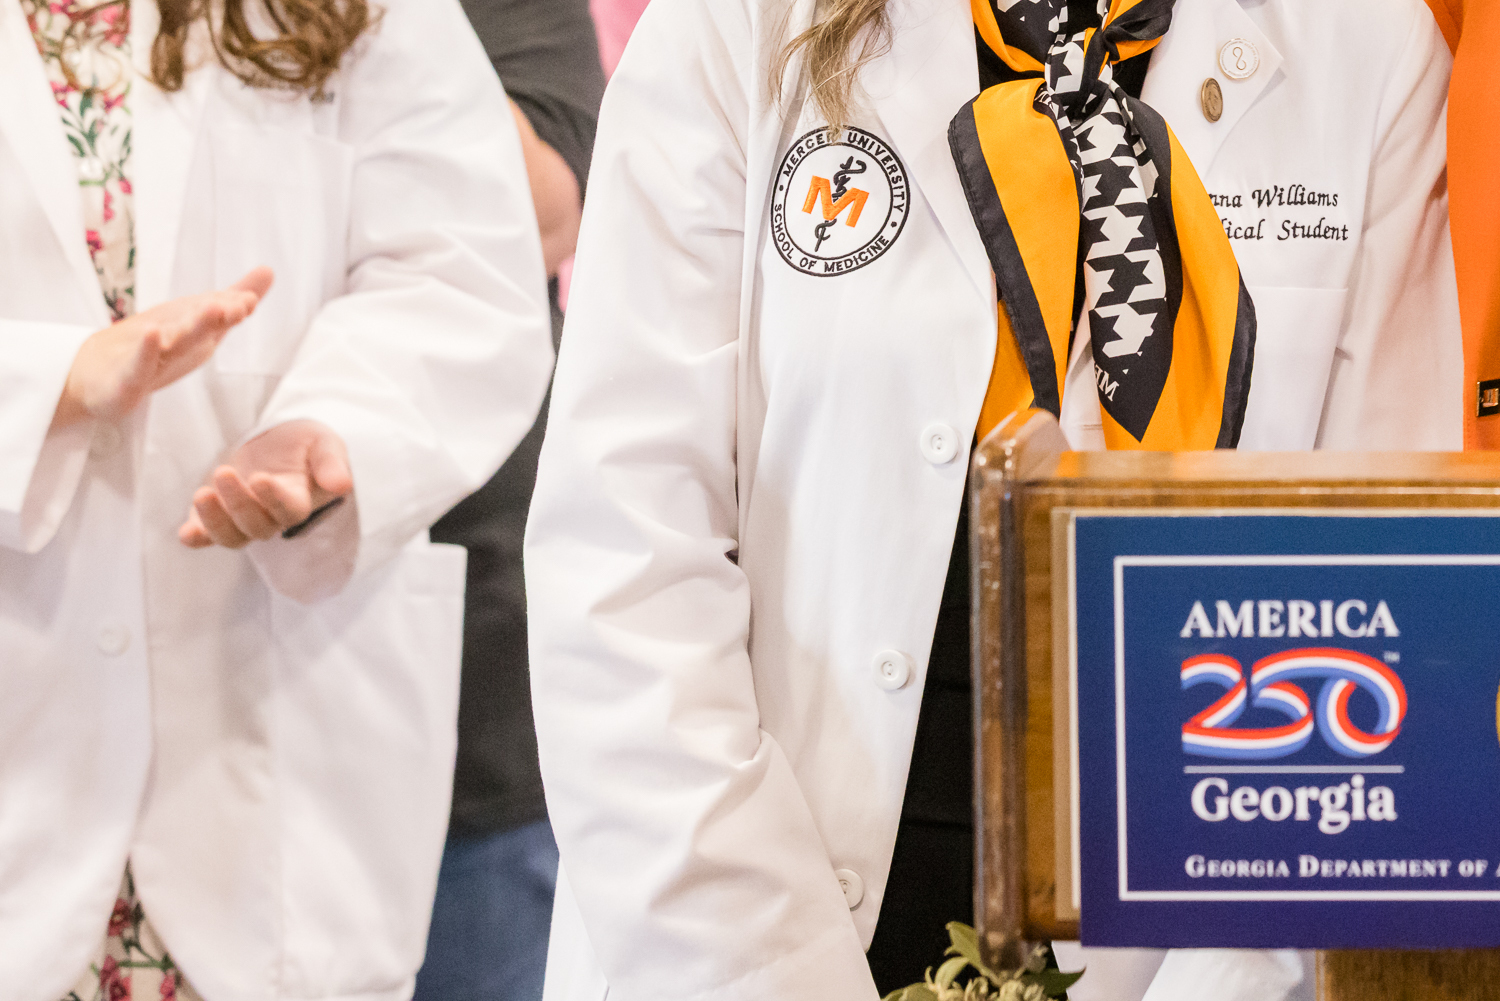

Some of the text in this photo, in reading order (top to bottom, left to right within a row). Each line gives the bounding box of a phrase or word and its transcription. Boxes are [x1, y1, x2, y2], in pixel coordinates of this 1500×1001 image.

[847, 132, 905, 213] UNIVERSITY
[1252, 184, 1338, 208] Williams
[802, 175, 870, 228] M
[1277, 217, 1349, 241] Student
[774, 204, 889, 273] SCHOOL OF MEDICINE
[1180, 599, 1400, 638] AMERICA
[1180, 647, 1408, 760] 250
[1190, 774, 1398, 835] Georgia
